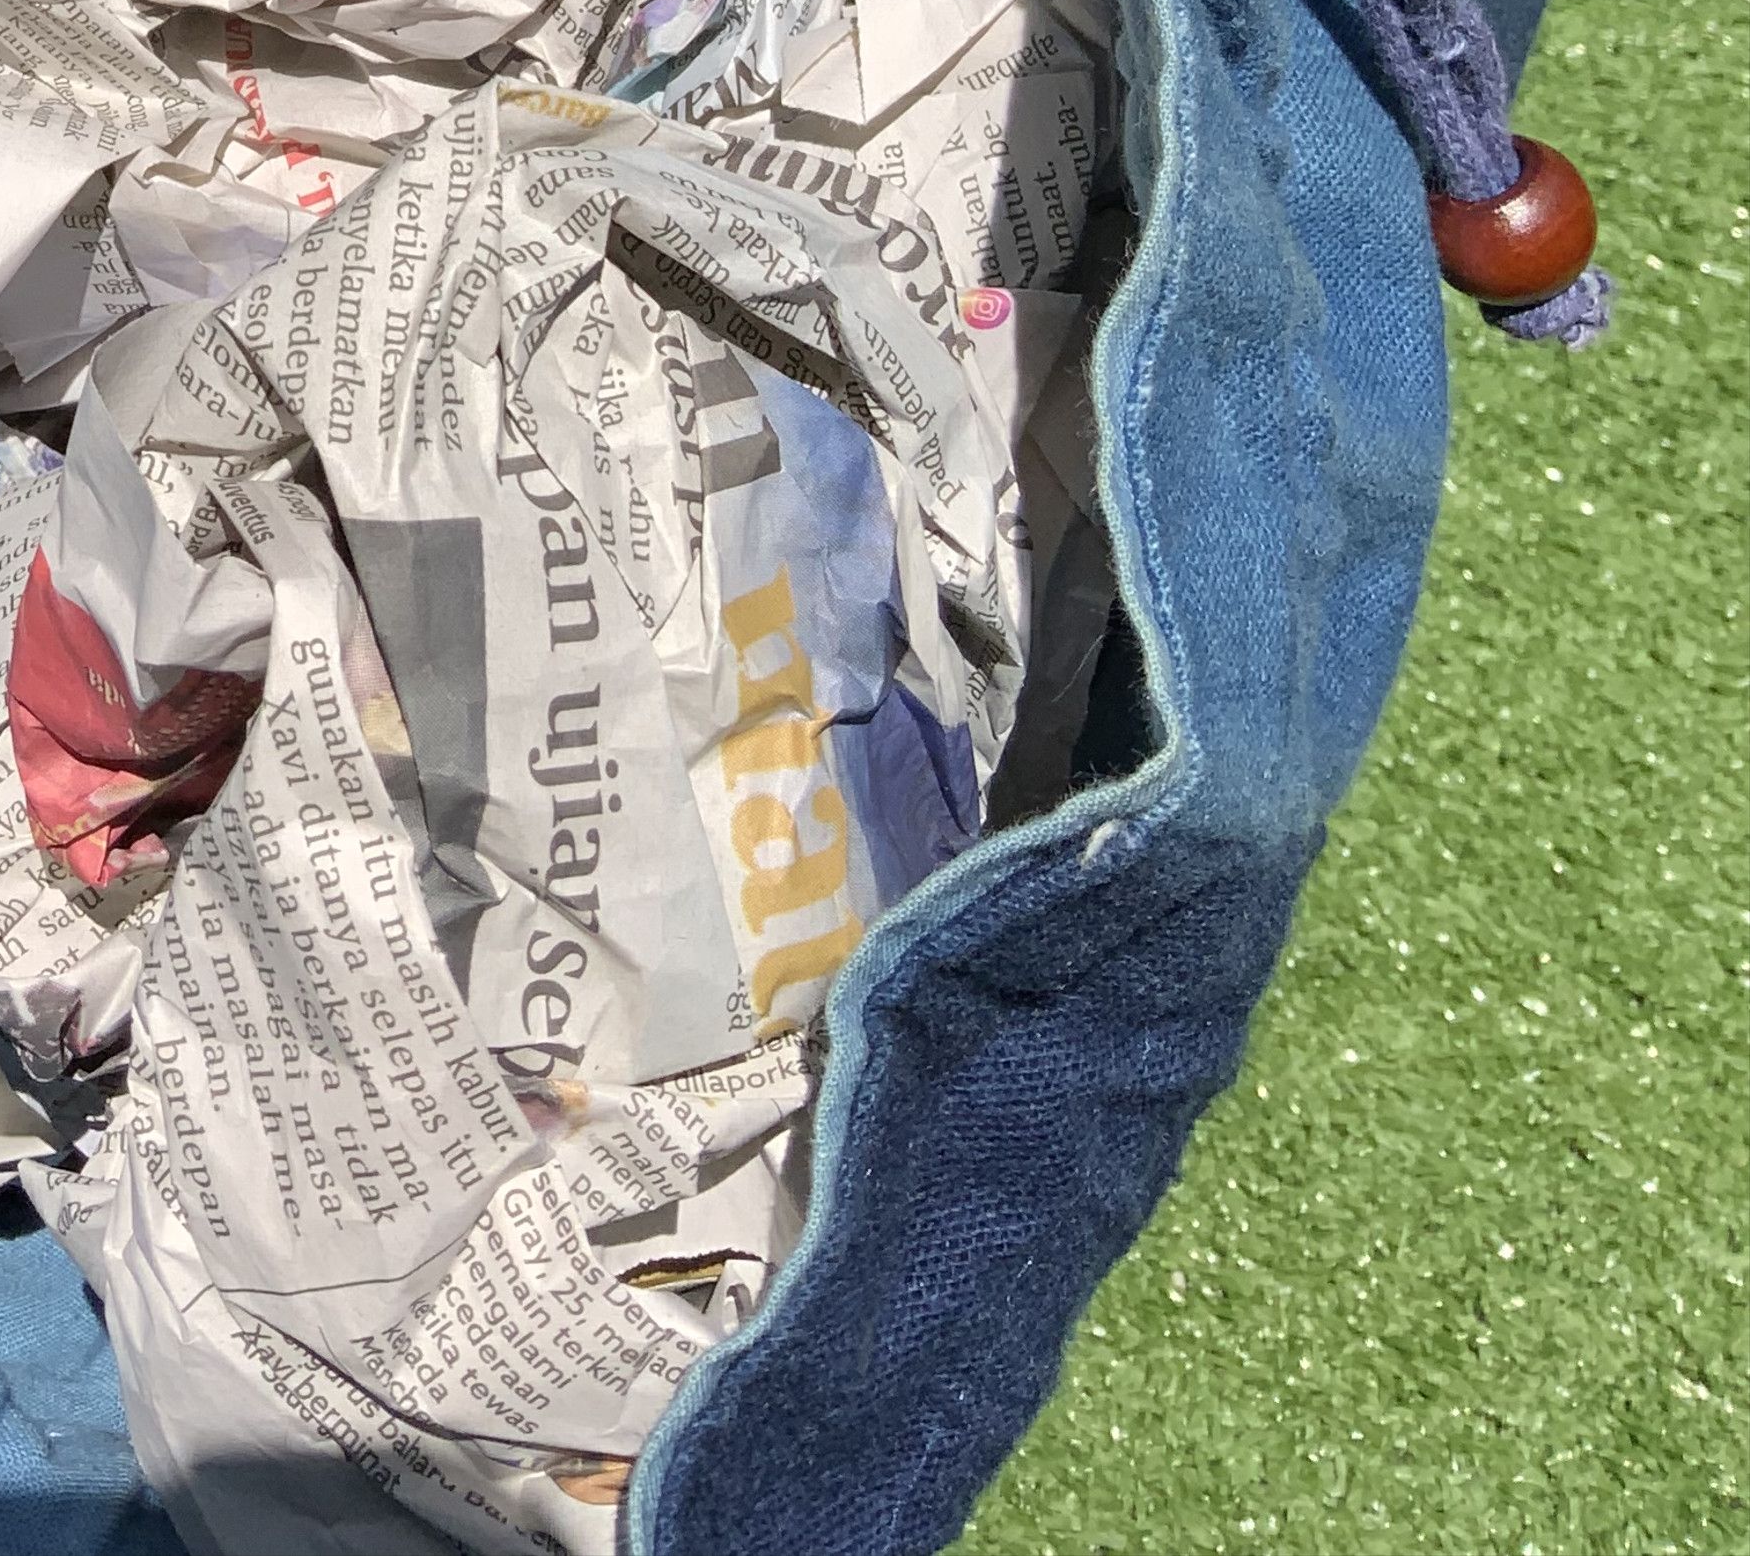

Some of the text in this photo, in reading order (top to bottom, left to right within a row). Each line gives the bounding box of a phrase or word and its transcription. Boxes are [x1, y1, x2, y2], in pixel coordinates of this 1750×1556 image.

[442, 111, 483, 203] ujian
[880, 139, 913, 190] dia
[974, 106, 1011, 162] be-
[277, 267, 326, 417] berdepa
[378, 178, 431, 451] ketika memu-
[35, 883, 106, 938] satu
[259, 691, 490, 1193] Xavi ditanya selepas itu
[283, 633, 527, 1157] gunakan itu masih kabur.
[235, 783, 291, 864] ada
[270, 874, 309, 917] ia
[380, 1136, 441, 1219] ma-
[195, 899, 313, 1239] ia masalah me-
[231, 916, 312, 1086] sebagai
[283, 1096, 356, 1234] masa-
[148, 1035, 239, 1245] berdepan
[328, 1118, 404, 1229] tidak
[608, 1126, 685, 1206] mahu
[466, 1208, 564, 1327] pemain
[488, 1187, 600, 1330] Gray, 25,
[521, 1173, 613, 1287] selepas
[376, 1314, 459, 1404] kepada
[402, 1290, 471, 1365] ketika
[455, 1365, 544, 1440] tewas
[289, 1371, 410, 1497] berminat
